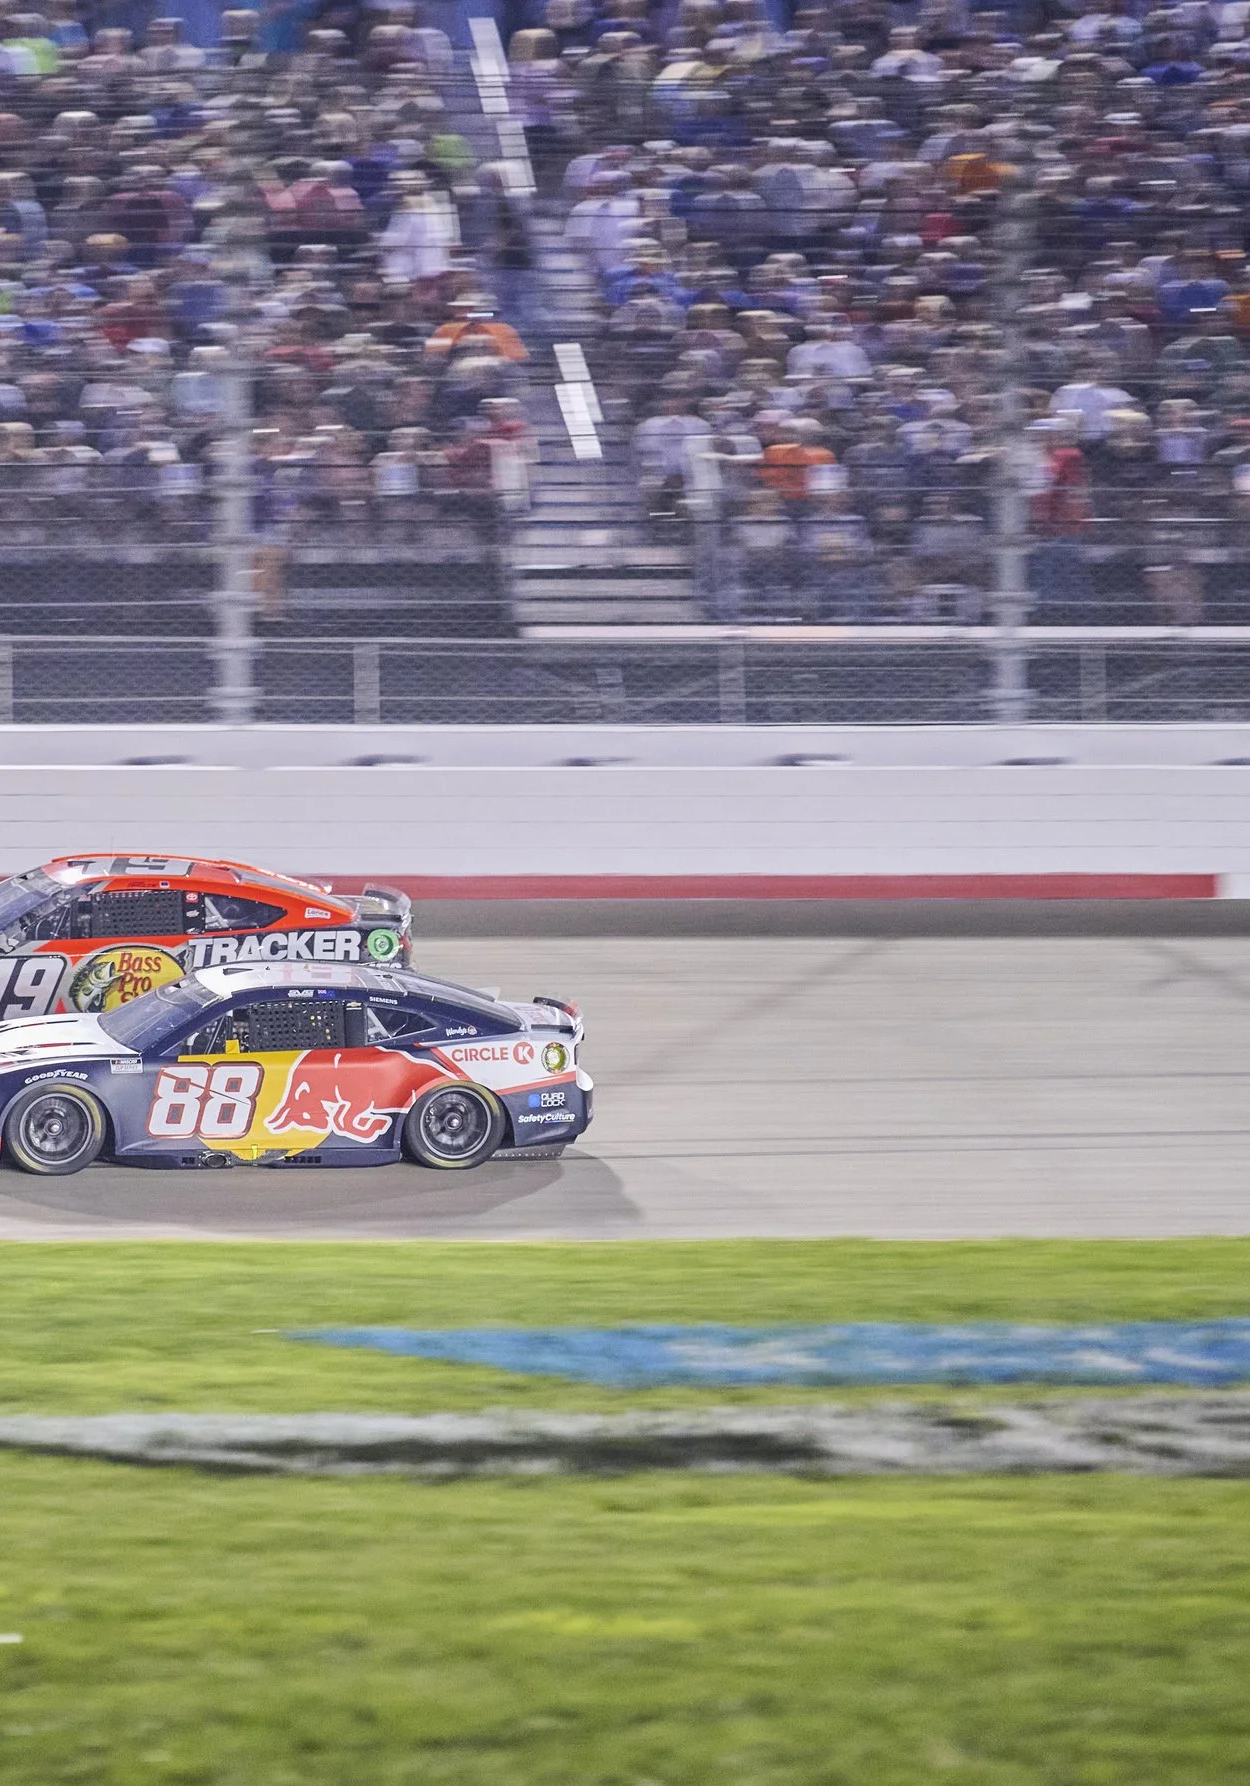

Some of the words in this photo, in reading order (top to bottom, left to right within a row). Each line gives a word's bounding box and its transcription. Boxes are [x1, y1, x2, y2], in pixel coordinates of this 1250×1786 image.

[189, 930, 361, 968] TRACKER
[118, 953, 161, 972] Bass
[119, 973, 152, 992] Pro
[369, 996, 398, 1005] SIEMENS
[446, 1026, 468, 1037] Wendy's
[451, 1047, 509, 1062] CIRCLE
[516, 1045, 534, 1062] K
[24, 1069, 89, 1085] GOODYEAR
[146, 1061, 264, 1139] 88
[541, 1092, 565, 1100] QUAD
[541, 1100, 565, 1108] LOCK
[518, 1113, 576, 1124] SafetyCulture
